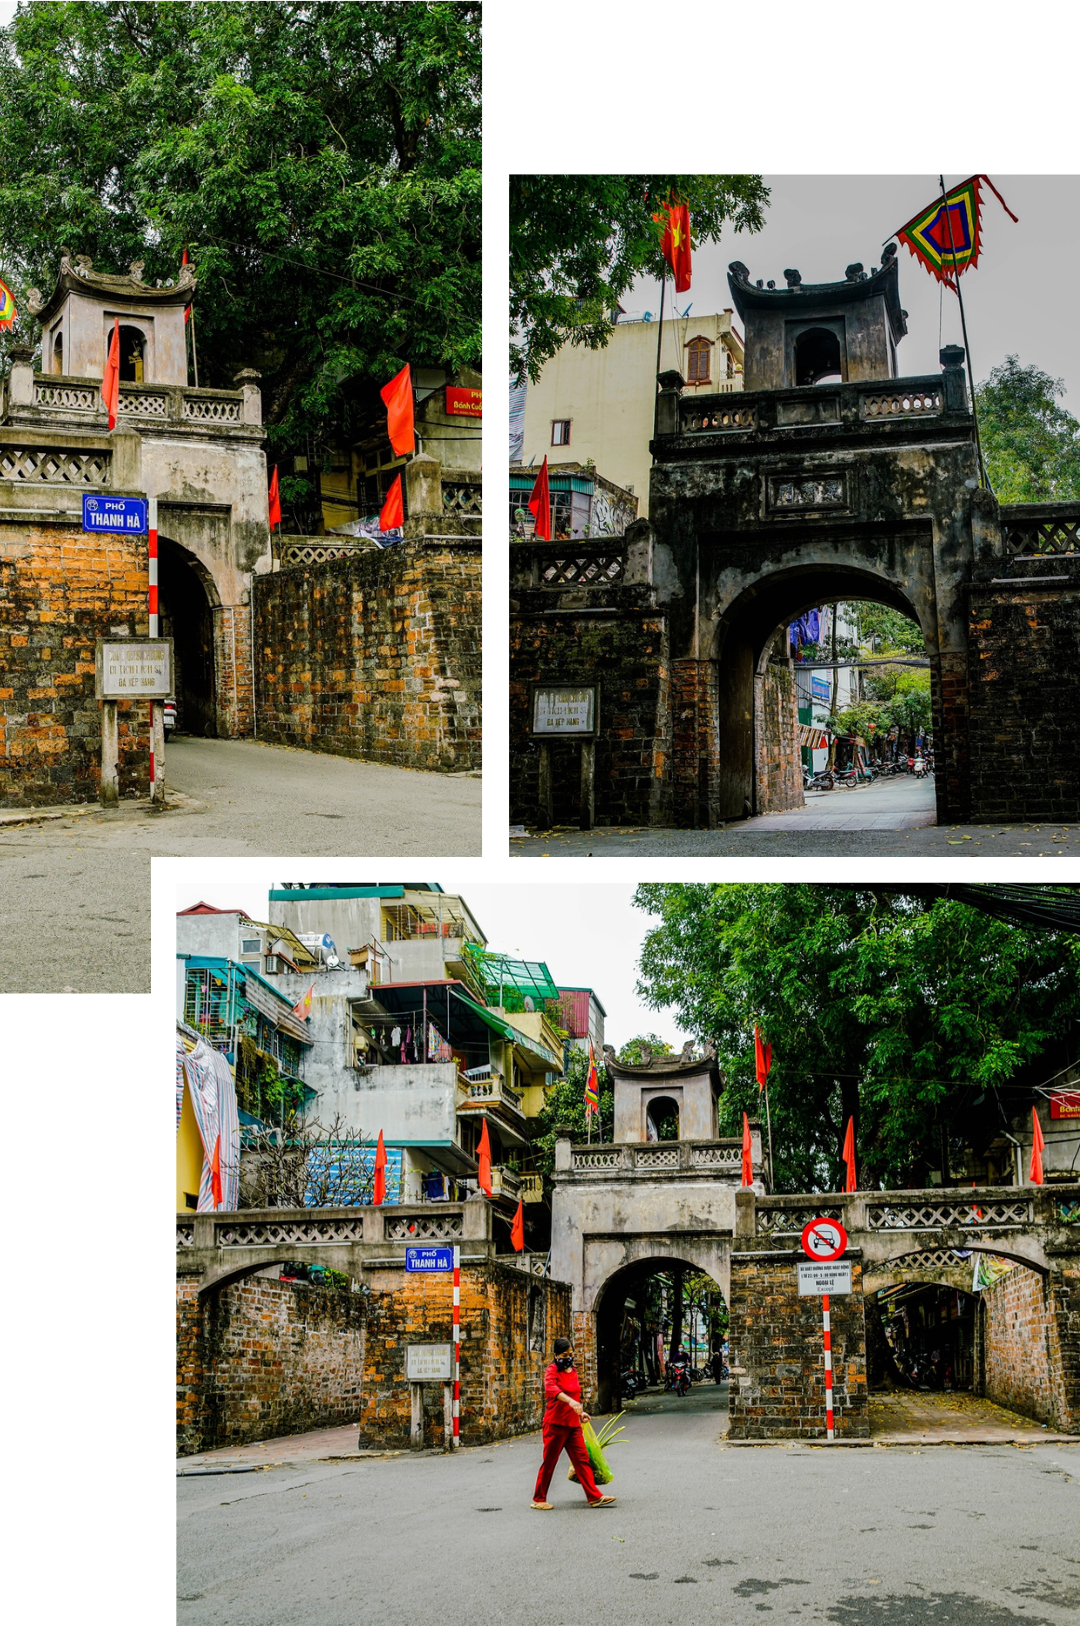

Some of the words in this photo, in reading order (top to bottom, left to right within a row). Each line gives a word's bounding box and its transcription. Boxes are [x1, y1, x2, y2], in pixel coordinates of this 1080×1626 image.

[454, 401, 470, 409] Bánh
[104, 500, 126, 510] PHỐ
[90, 512, 124, 527] THANH
[126, 512, 140, 528] HÀ
[422, 1250, 437, 1258] PHỐ
[410, 1258, 436, 1268] THANH
[438, 1256, 448, 1268] HÀ
